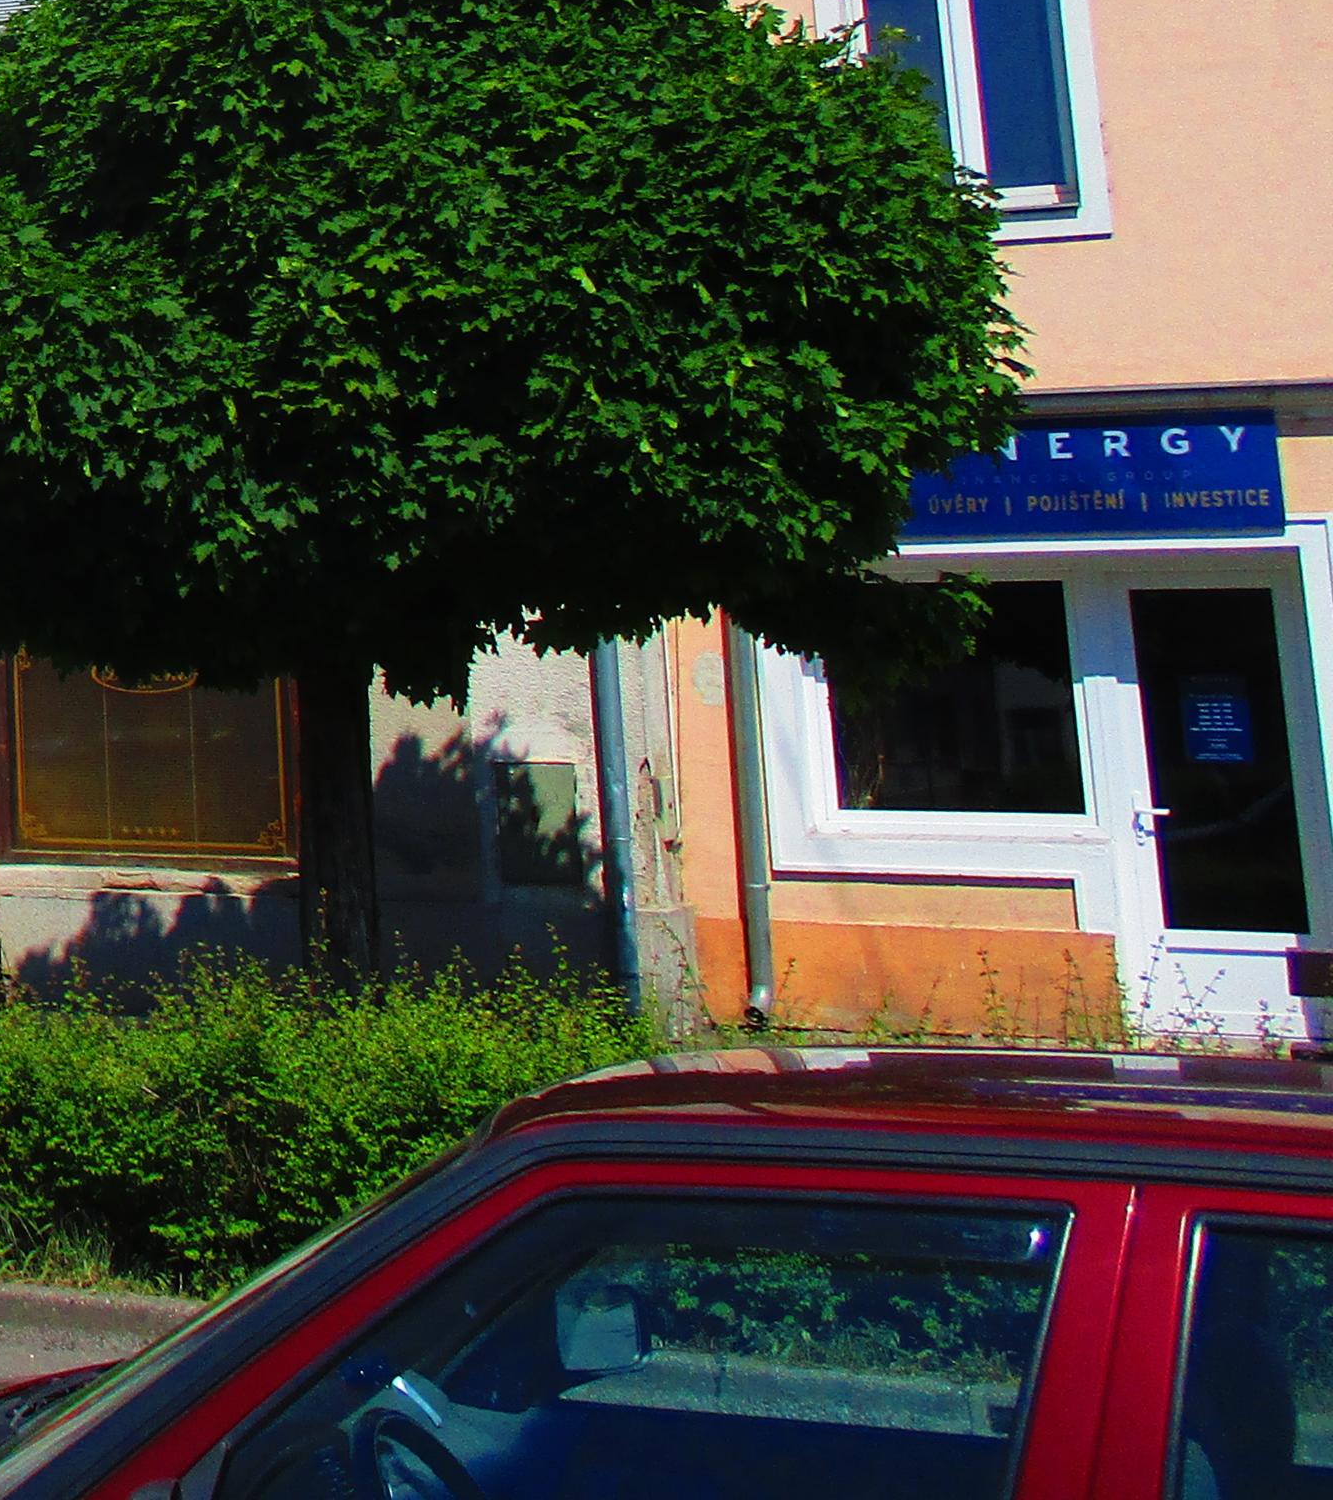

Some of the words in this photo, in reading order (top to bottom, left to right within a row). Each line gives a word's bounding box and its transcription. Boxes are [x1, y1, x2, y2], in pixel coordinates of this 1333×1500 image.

[995, 426, 1245, 461] NERGY
[1027, 489, 1125, 512] POJIŠTĚNÍ
[1165, 489, 1270, 509] INVESTICE
